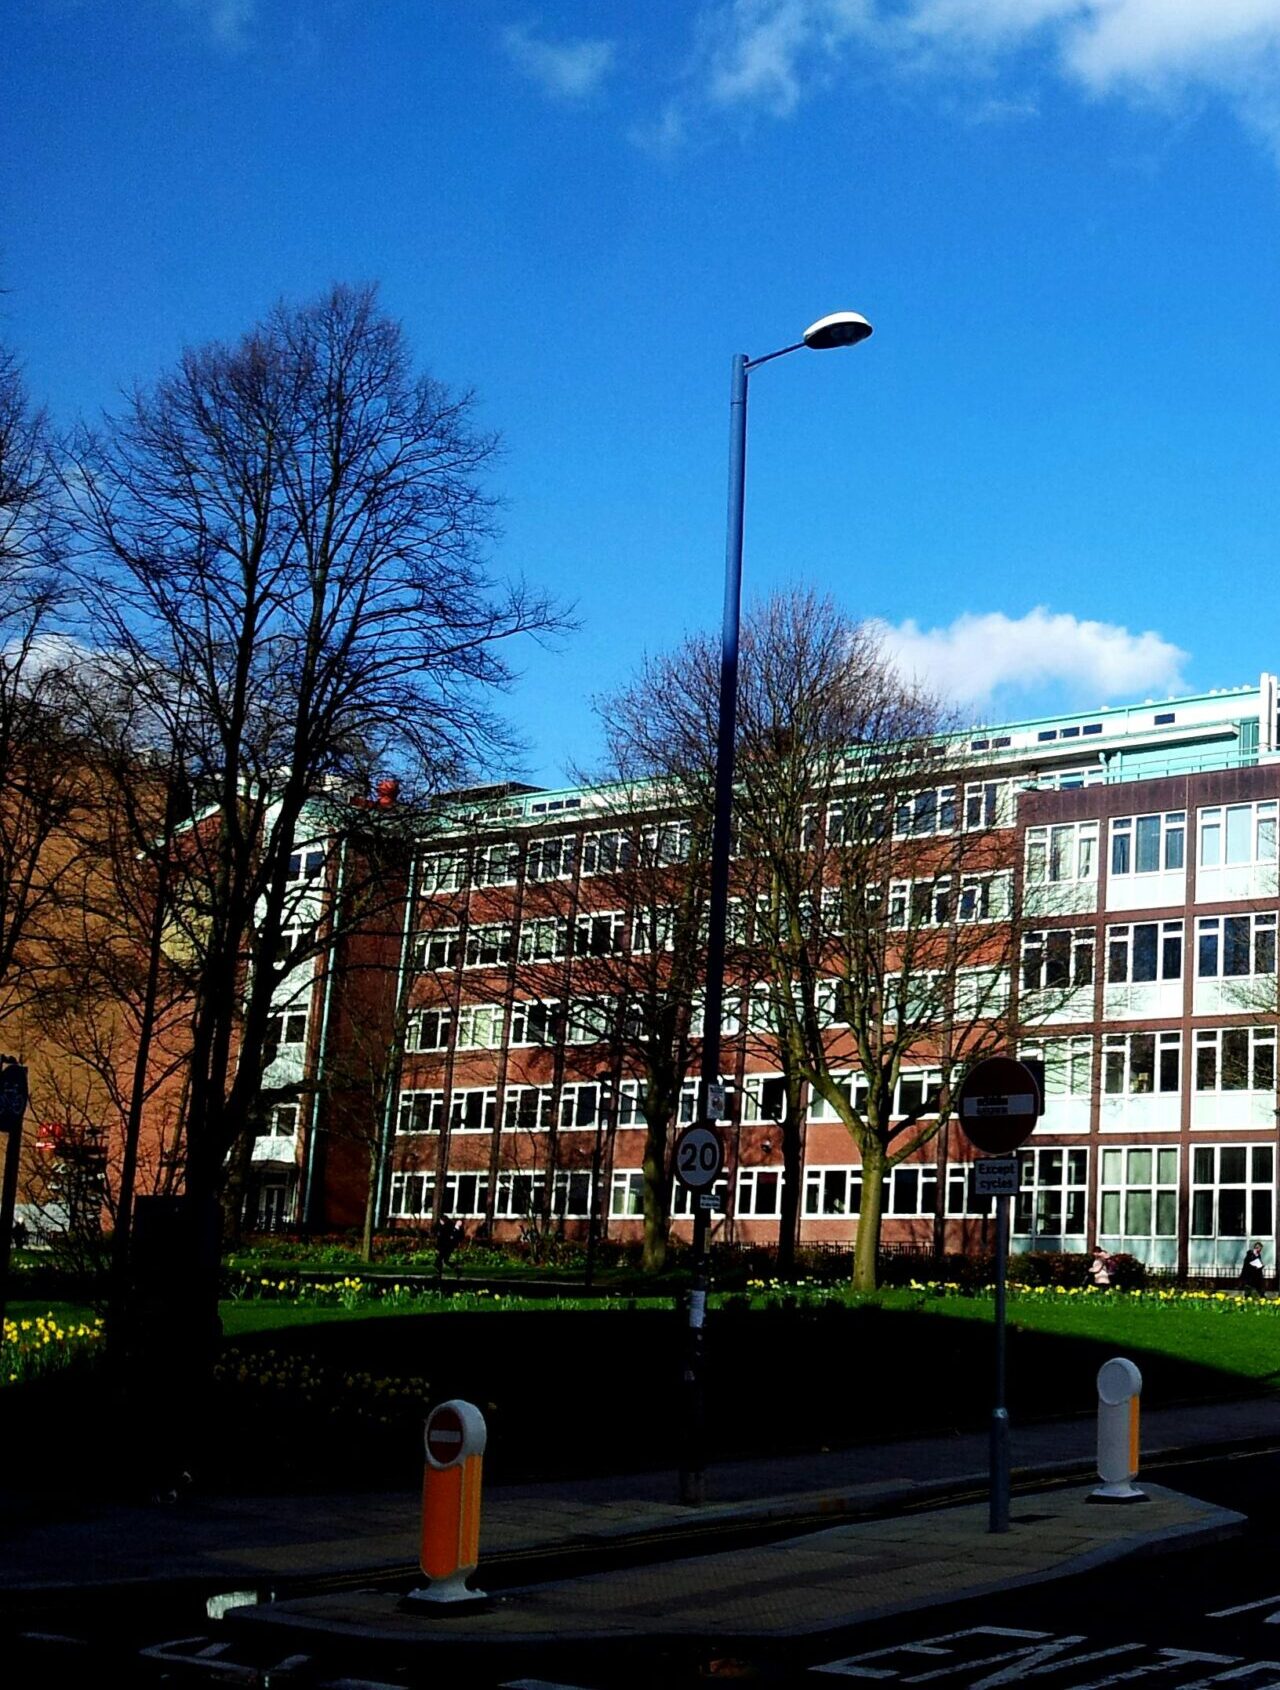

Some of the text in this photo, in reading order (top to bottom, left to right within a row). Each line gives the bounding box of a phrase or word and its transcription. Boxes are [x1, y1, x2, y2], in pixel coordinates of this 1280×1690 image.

[681, 1142, 717, 1171] 20
[978, 1163, 1016, 1176] Except
[980, 1178, 1013, 1190] cycles
